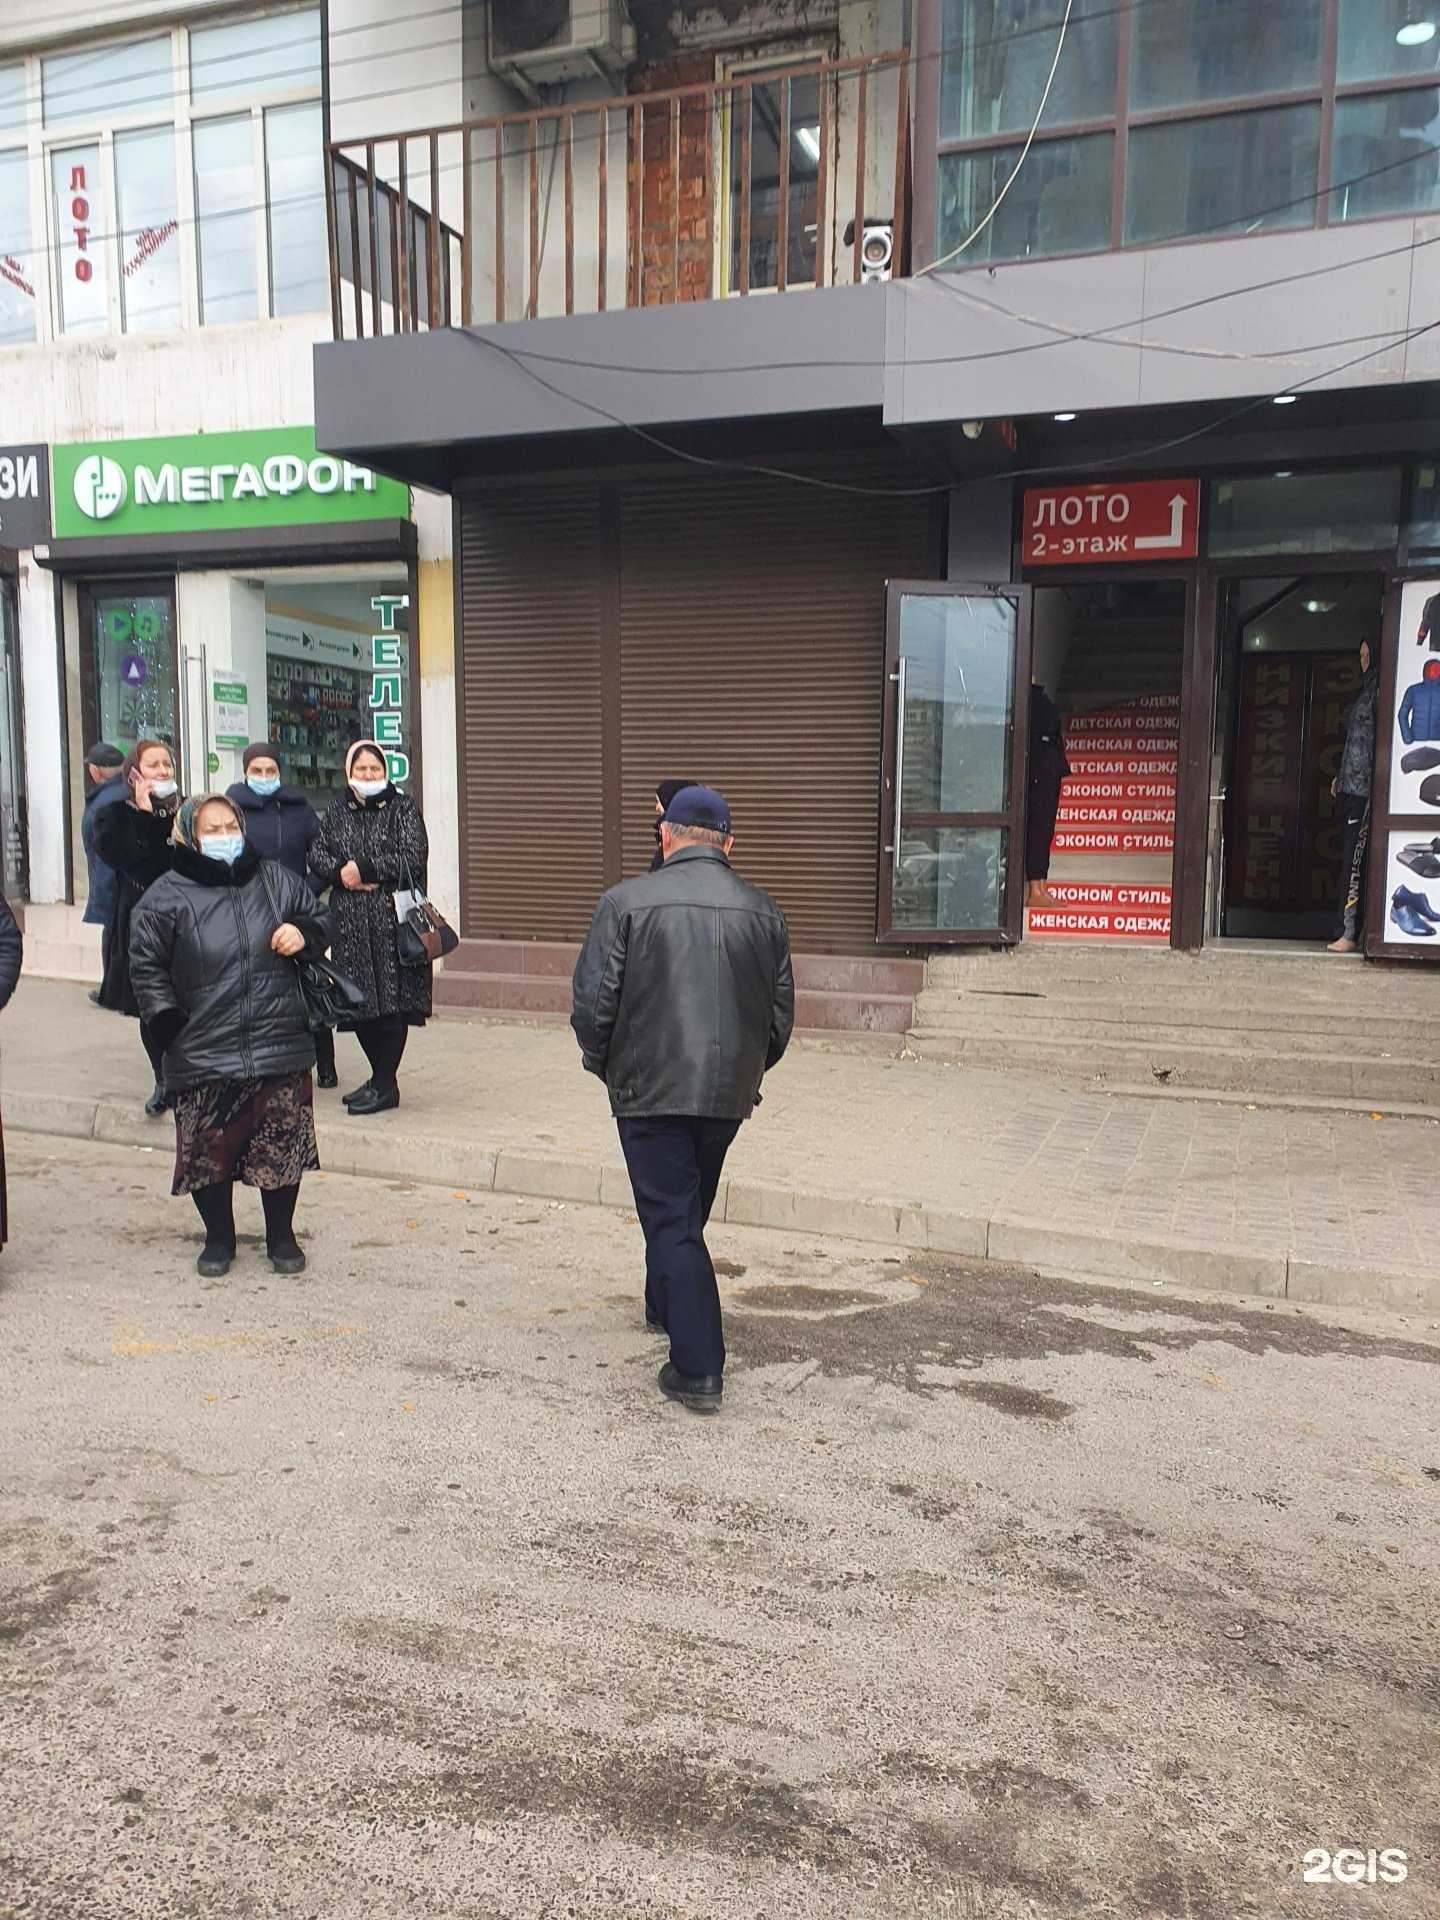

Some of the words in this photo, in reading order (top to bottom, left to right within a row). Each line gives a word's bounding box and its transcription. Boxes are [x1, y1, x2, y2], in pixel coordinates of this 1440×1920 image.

[70, 165, 92, 282] ЛОТО
[134, 455, 377, 504] МЕГАФОН
[1032, 494, 1130, 527] ЛОТО
[1032, 533, 1128, 556] 2-этаж
[369, 594, 410, 795] ТЕЛЕФ
[1070, 718, 1132, 730] ДЕТСКАЯ
[1249, 663, 1291, 802] НИЗКИЕ
[1065, 739, 1132, 750] ЖЕНСКАЯ
[1070, 761, 1124, 773] ЕТСКАЯ
[1062, 785, 1122, 797] ЭКОНОМ
[1127, 785, 1175, 797] СТИЛЬ
[1055, 834, 1118, 847] ЭКОНОМ
[1123, 835, 1174, 848] СТИЛЬ
[1047, 887, 1113, 902] ЭКОНОМ
[1117, 889, 1171, 904] СТИЛЬ
[1031, 914, 1109, 929] ЖЕНСКАЯ
